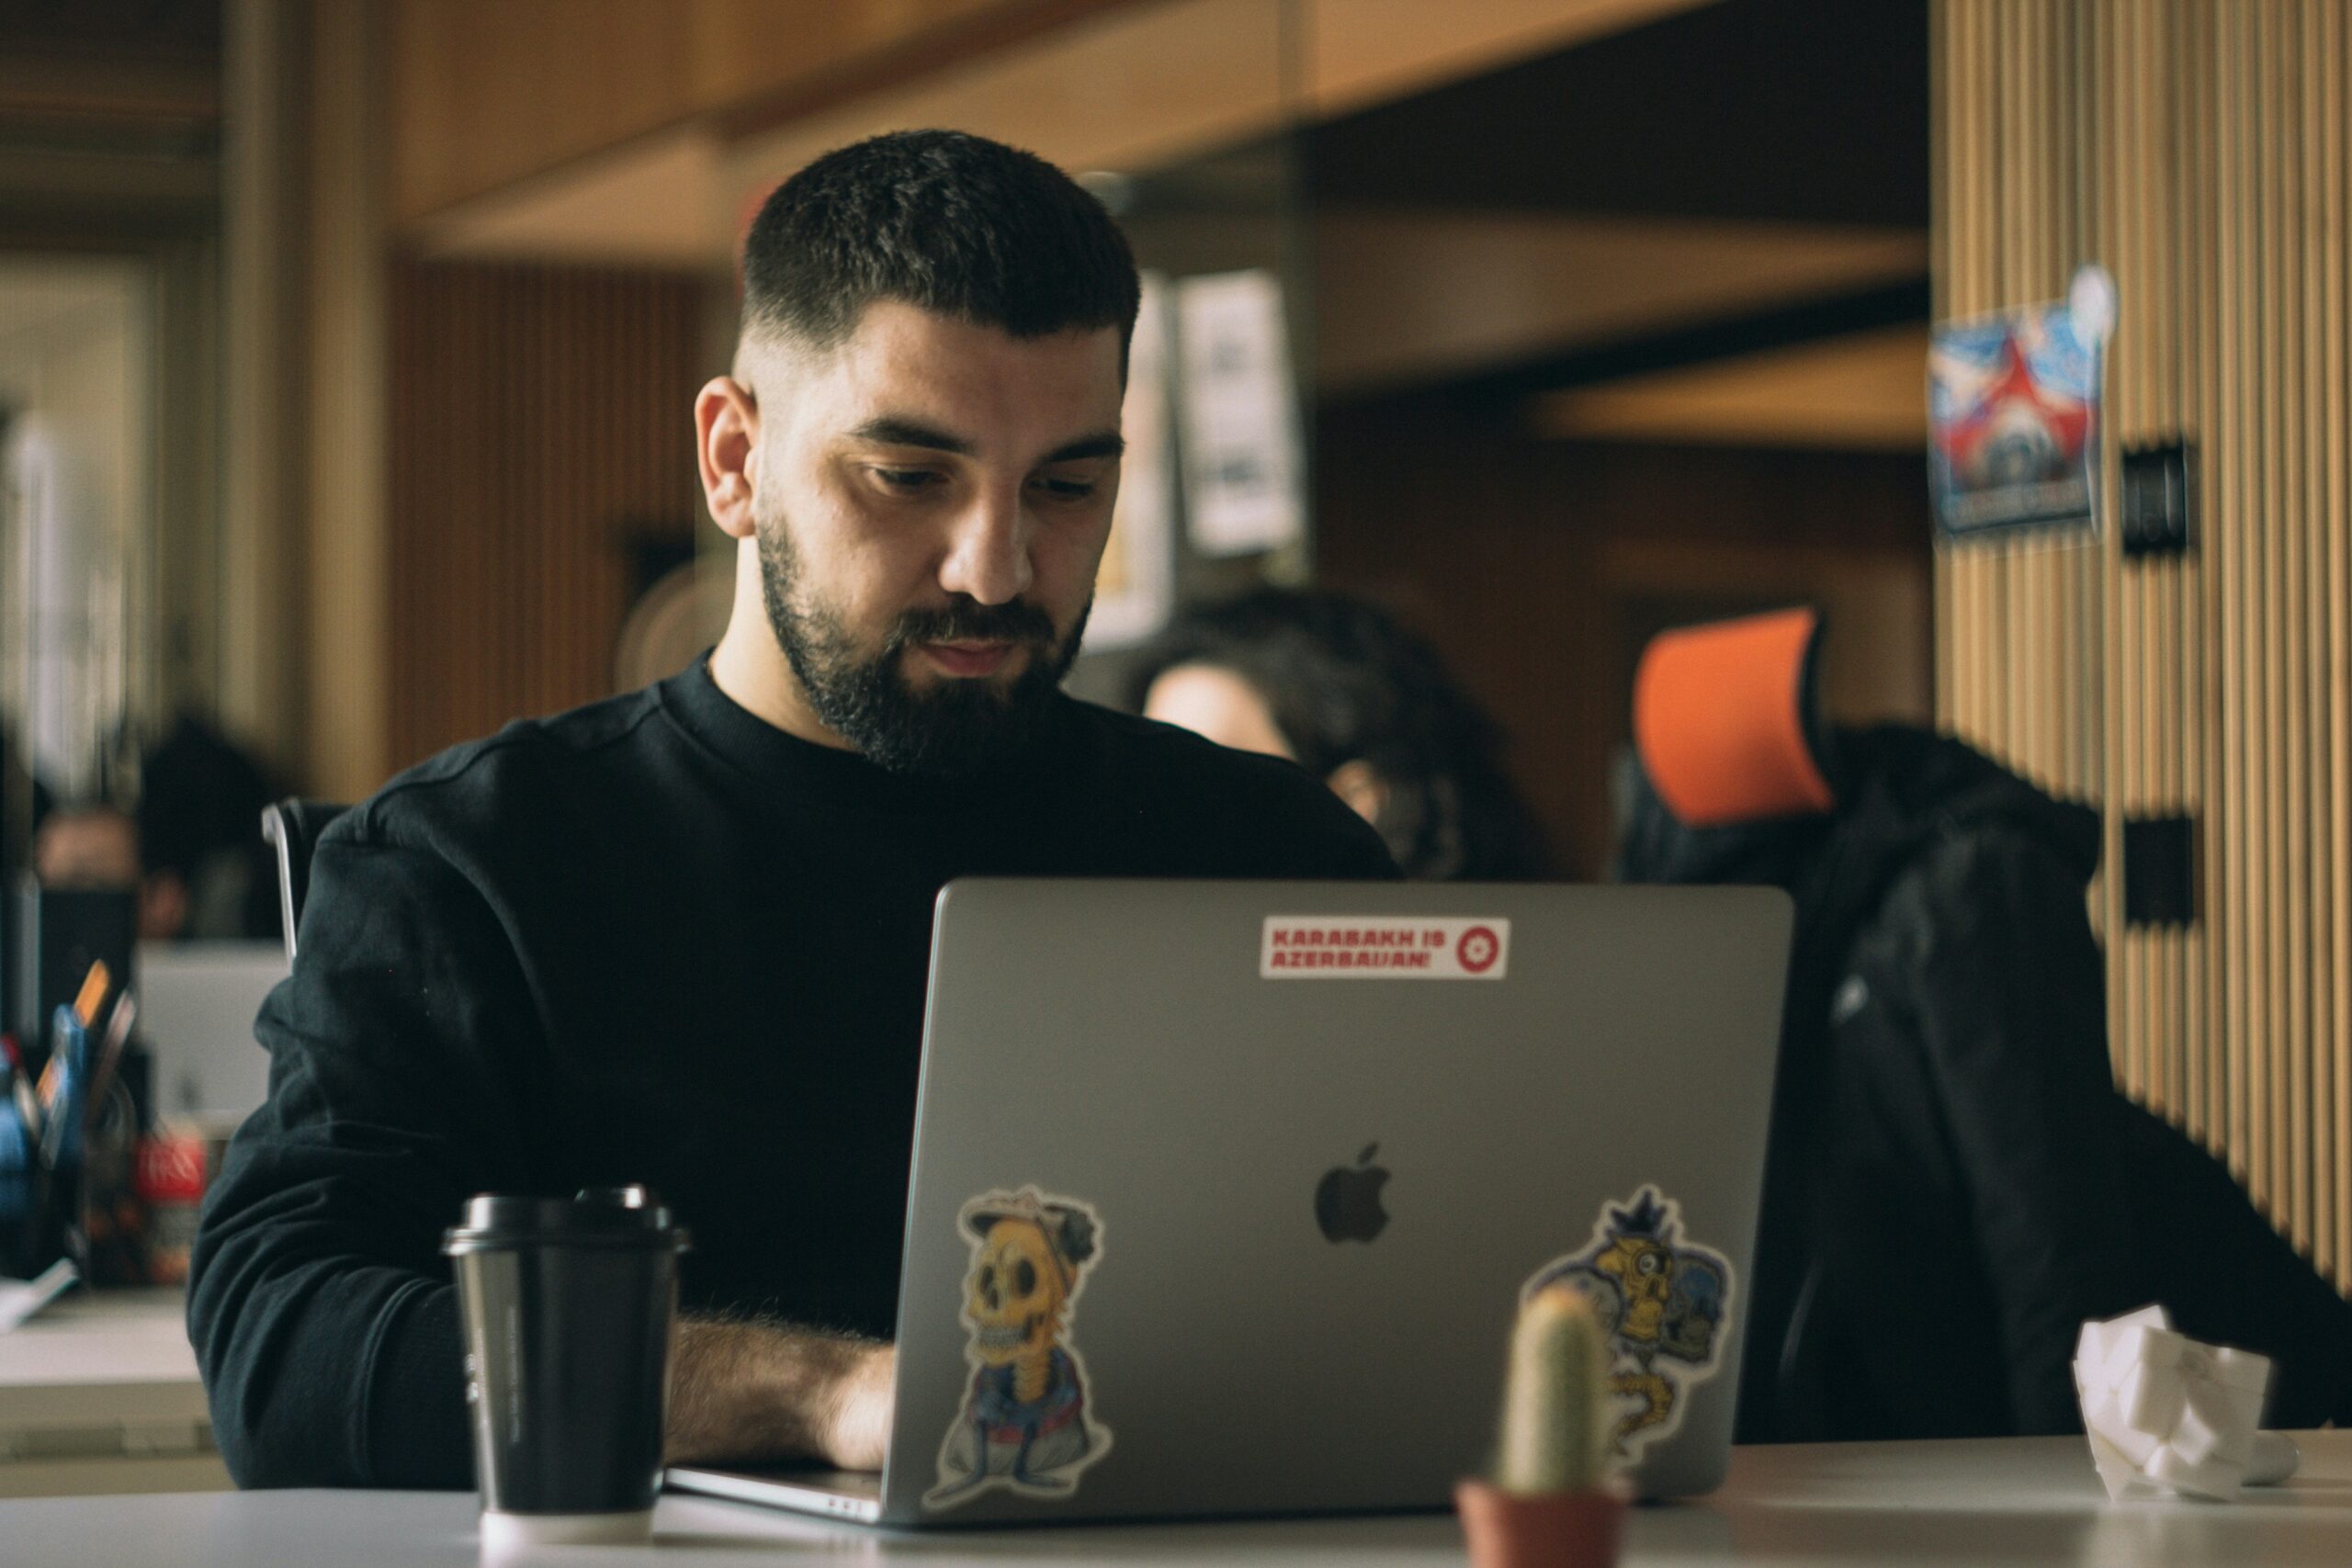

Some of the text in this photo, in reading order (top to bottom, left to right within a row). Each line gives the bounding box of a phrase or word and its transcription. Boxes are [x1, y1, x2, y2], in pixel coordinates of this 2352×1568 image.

[1272, 930, 1446, 948] KARABAKH IS
[1271, 951, 1432, 968] AZERBAIJAN!
